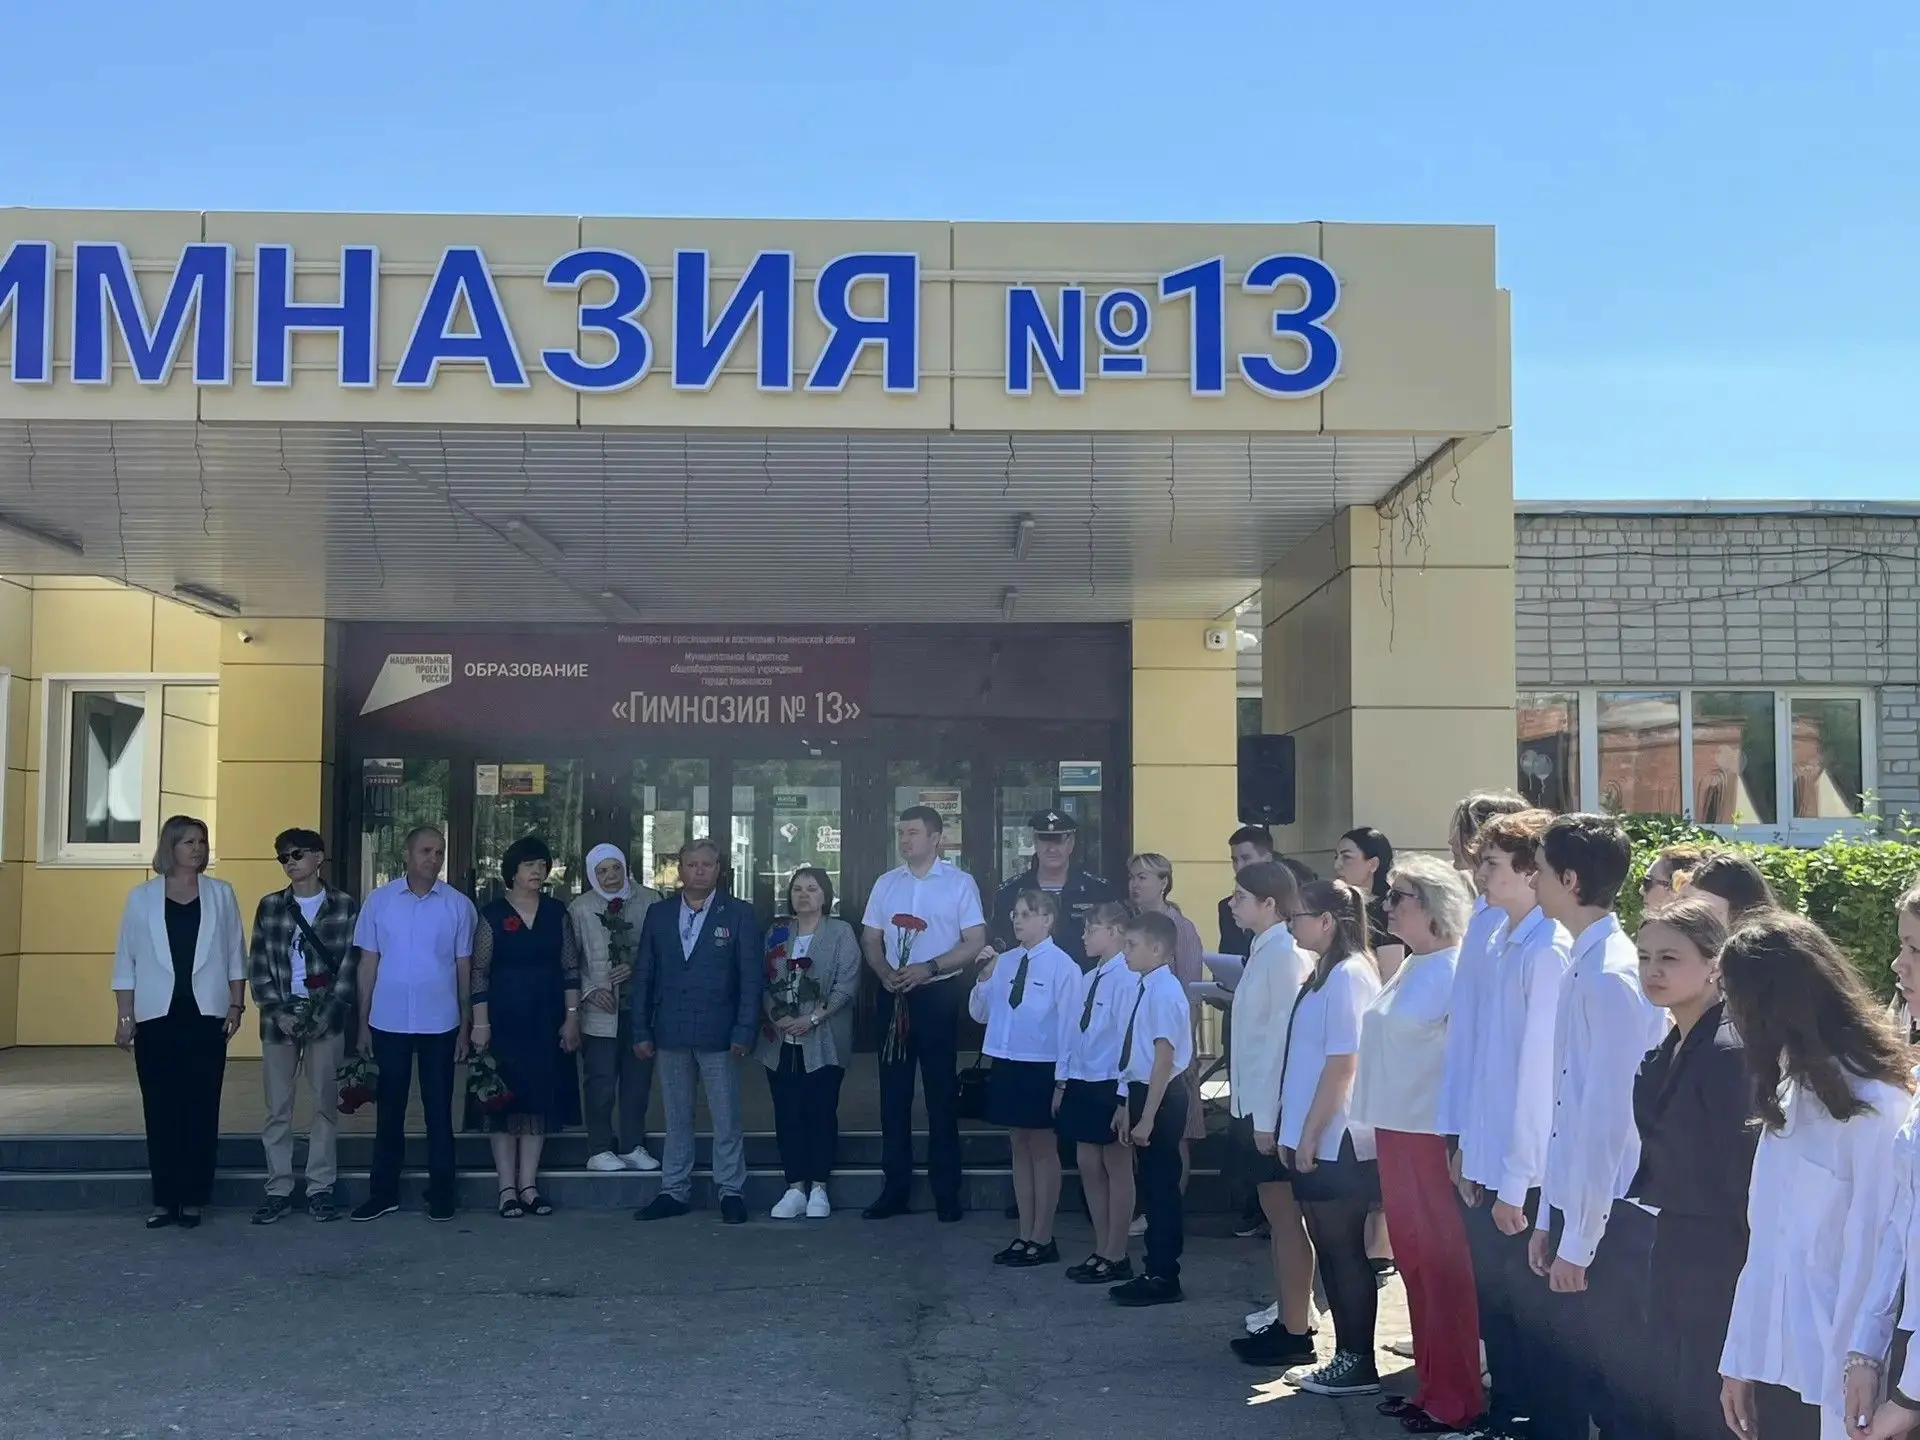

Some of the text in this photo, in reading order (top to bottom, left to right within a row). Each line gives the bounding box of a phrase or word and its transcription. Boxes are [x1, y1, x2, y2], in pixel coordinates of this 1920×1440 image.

[390, 655, 449, 665] НАЦИОНАЛЬНЫЕ
[415, 665, 449, 674] ПРОЕКТЫ
[464, 663, 589, 677] ОБРАЗОВАНИЕ
[421, 674, 449, 683] РОССИИ
[815, 691, 861, 724] 13»
